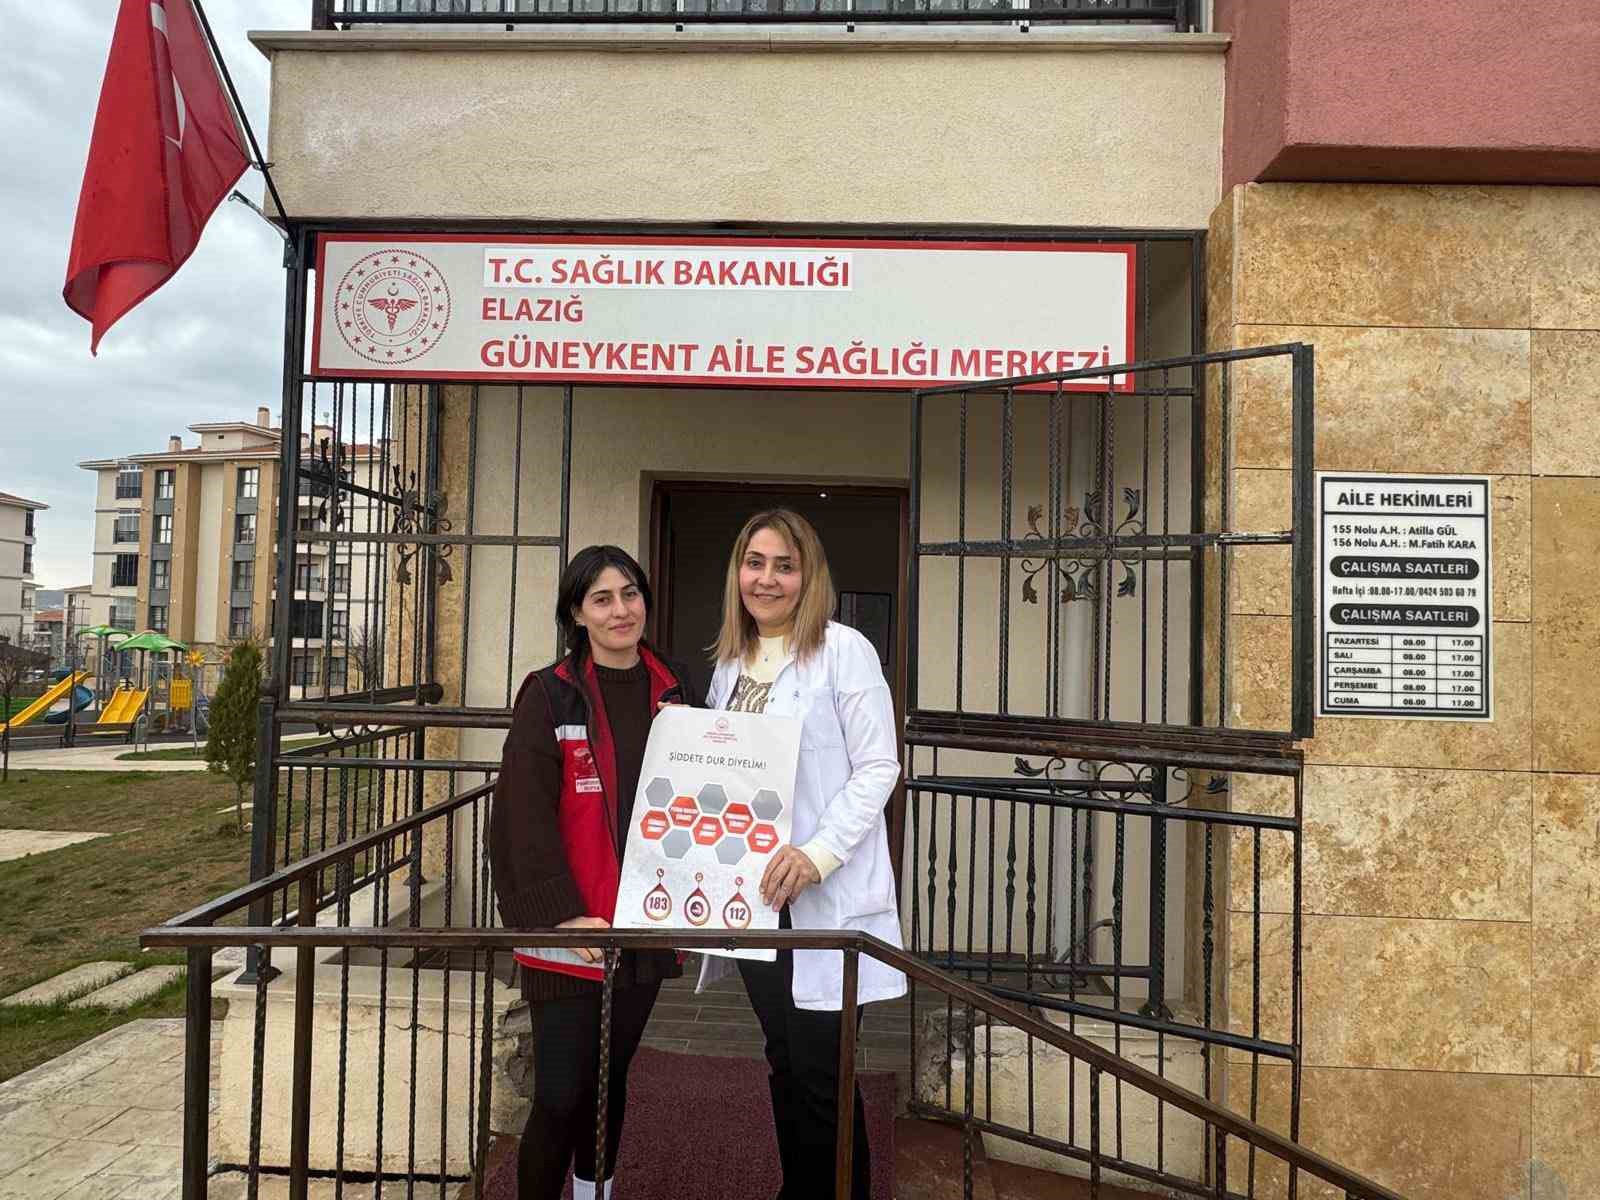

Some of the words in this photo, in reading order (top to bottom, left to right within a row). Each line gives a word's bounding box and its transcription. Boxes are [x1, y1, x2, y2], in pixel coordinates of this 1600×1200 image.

[488, 257, 542, 284] T.C.
[551, 254, 662, 286] SAĞLIK
[674, 256, 849, 287] BAKANLIĞI
[481, 293, 584, 322] ELAZIĞ
[480, 333, 699, 372] GÜNEYKENT
[707, 337, 785, 374] AİLE
[796, 340, 938, 377] SAĞLIĞI
[950, 344, 1110, 379] MERKEZİ
[1337, 488, 1374, 506] AİLE
[1380, 490, 1473, 508] HEKİMLERİ
[1333, 525, 1351, 534] 155
[1354, 525, 1377, 534] Nolu
[1408, 526, 1434, 535] Atilla
[1437, 524, 1457, 536] GÜL
[1333, 537, 1351, 547] 156
[1354, 538, 1377, 547] Nolu
[1408, 539, 1445, 549] M.Fatih
[1447, 540, 1476, 549] KARA
[1341, 561, 1401, 575] ÇALIŞMA
[1405, 562, 1468, 575] SAATLERİ
[1341, 608, 1401, 622] ÇALIŞMA
[1405, 609, 1468, 622] SAATLERİ
[1334, 637, 1379, 645] PAZARTESİ
[706, 755, 725, 766] DUR
[649, 896, 667, 910] 183
[729, 907, 745, 921] 112
